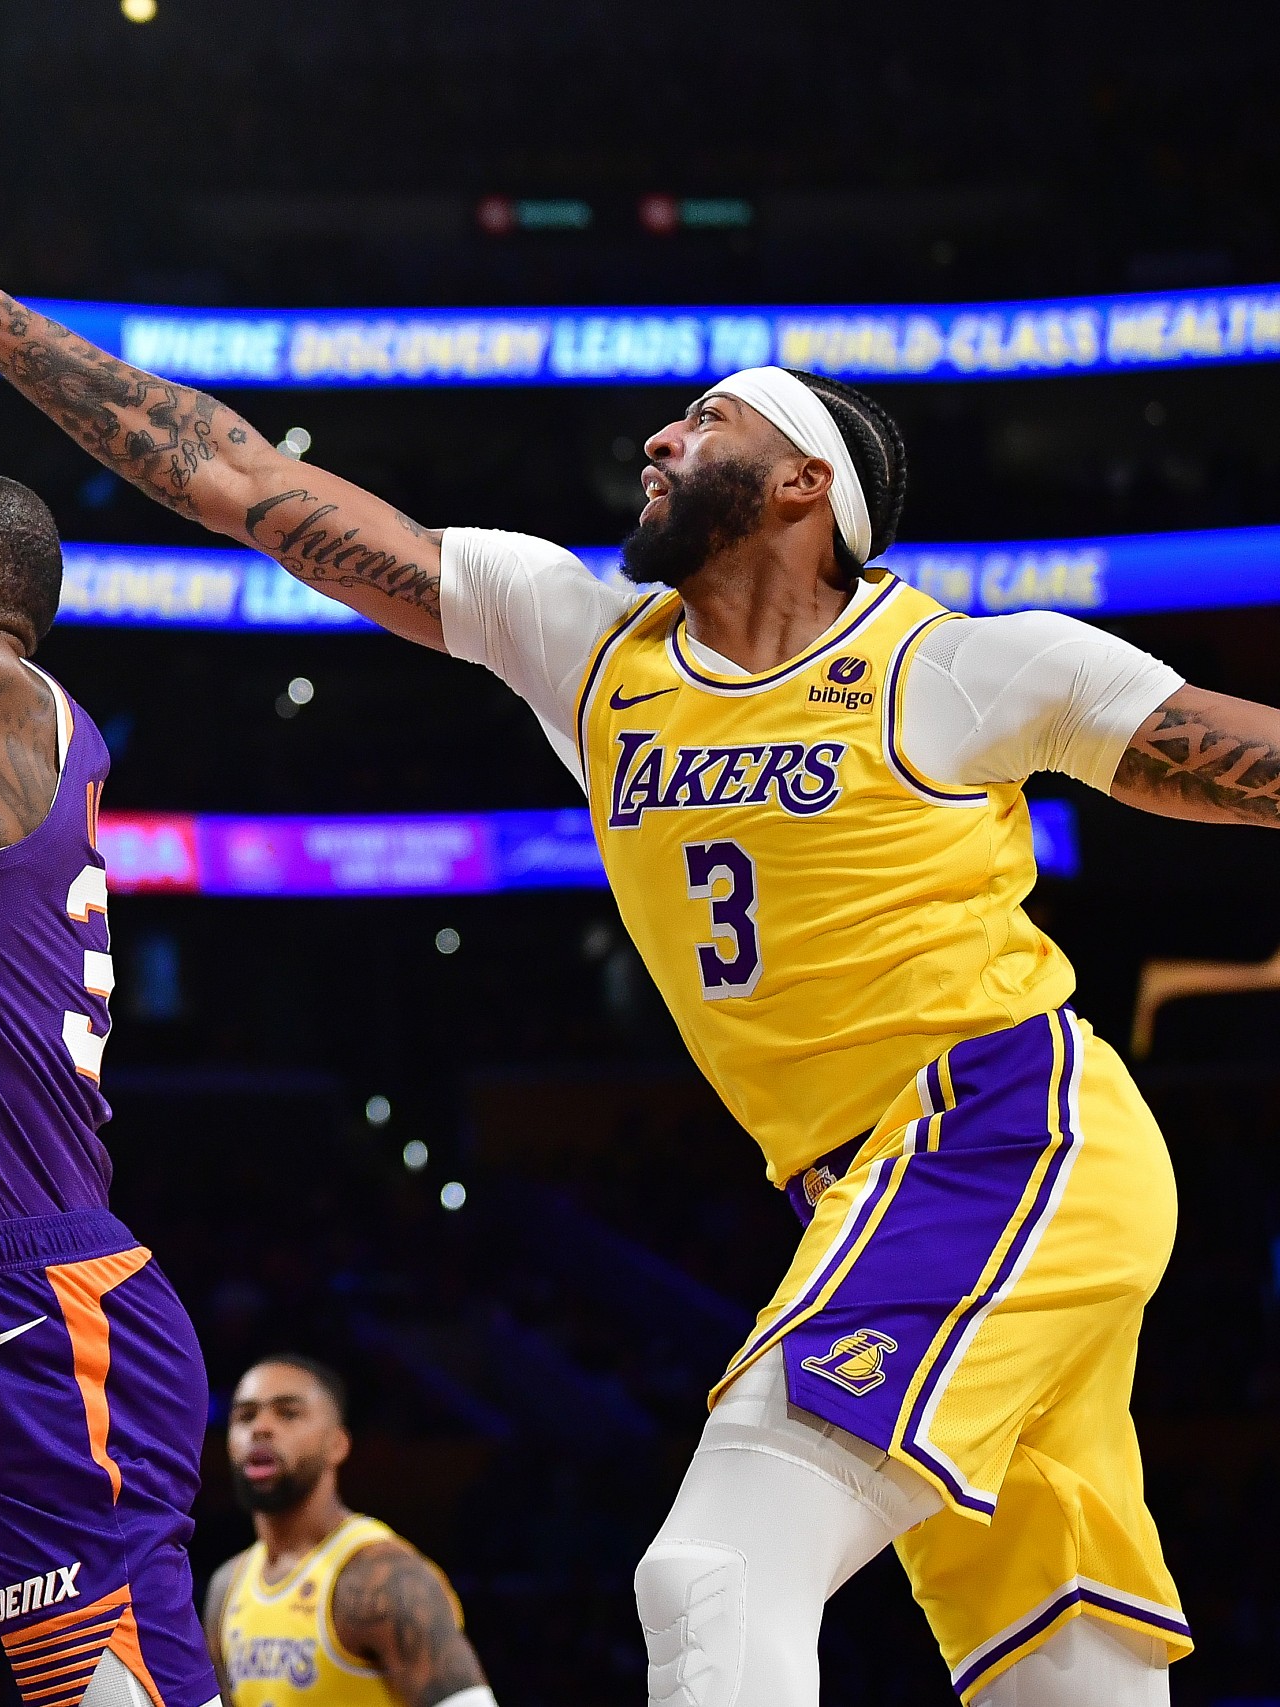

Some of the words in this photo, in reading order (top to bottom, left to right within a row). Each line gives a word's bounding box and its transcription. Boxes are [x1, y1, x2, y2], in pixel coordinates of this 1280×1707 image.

[808, 686, 874, 711] bibigo
[608, 730, 849, 830] LAKERS
[681, 838, 764, 1001] 3
